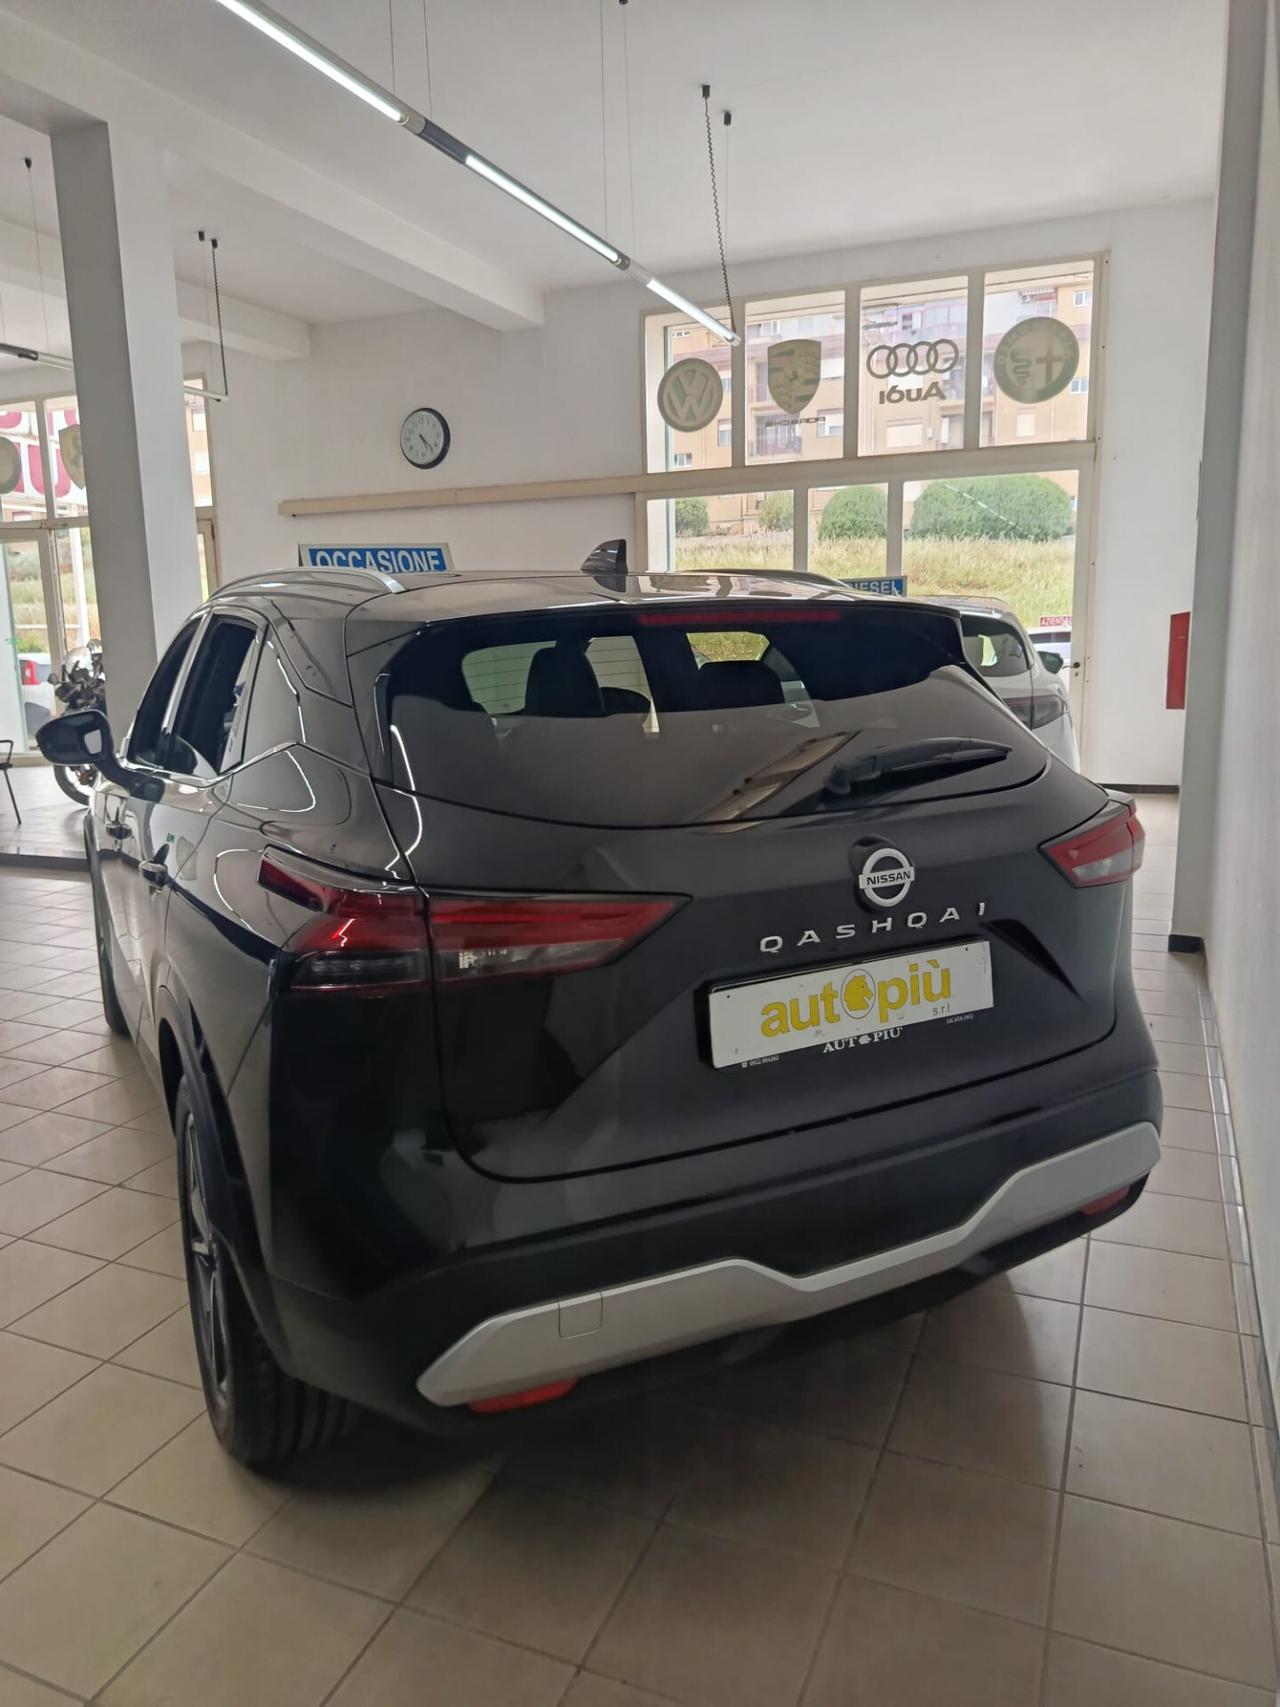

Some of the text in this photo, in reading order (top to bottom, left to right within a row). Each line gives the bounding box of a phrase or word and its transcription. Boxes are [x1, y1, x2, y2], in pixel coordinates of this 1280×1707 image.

[315, 550, 440, 573] OCCASIONE
[866, 870, 911, 886] NISSAN
[760, 902, 986, 953] QASHQAI
